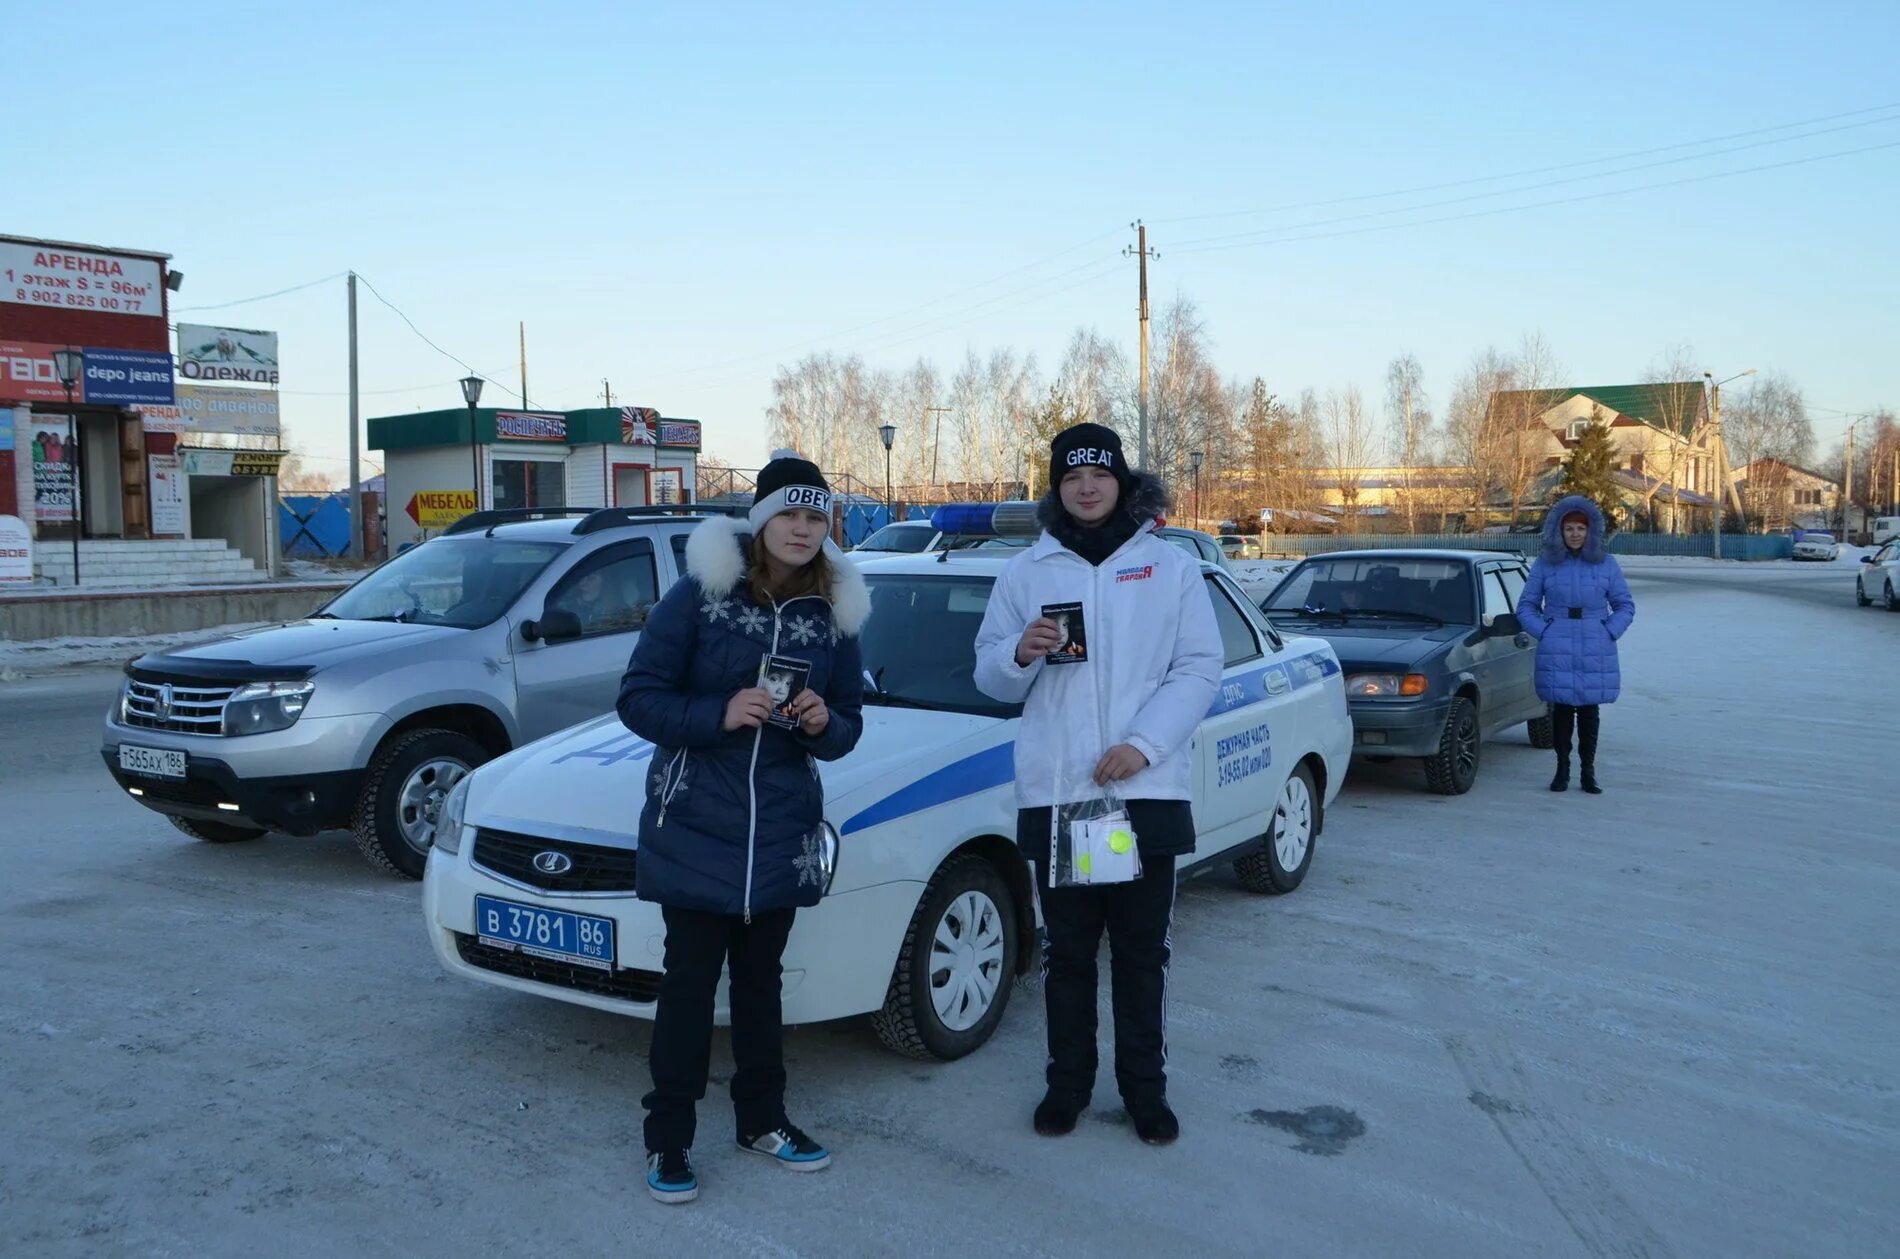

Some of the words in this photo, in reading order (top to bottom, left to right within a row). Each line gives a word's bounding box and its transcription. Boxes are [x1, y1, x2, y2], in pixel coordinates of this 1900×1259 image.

[33, 252, 124, 277] АРЕНДА
[5, 269, 14, 283] 1
[23, 274, 71, 288] этаж
[77, 277, 88, 290] S
[16, 288, 26, 300] 8
[32, 290, 61, 304] 902
[67, 293, 95, 307] 825
[101, 297, 119, 310] 00
[124, 300, 142, 312] 77
[87, 366, 126, 382] depo
[129, 368, 170, 383] jeans
[182, 360, 279, 384] Одежда
[208, 399, 277, 415] ДИВАНОВ
[499, 416, 564, 436] РОСПЕЧАТЬ
[1066, 448, 1113, 467] GREAT
[40, 492, 72, 505] 20%
[420, 494, 474, 510] МЕБЕЛЬ
[788, 488, 830, 509] OBEY
[1222, 683, 1245, 707] ДПС
[1216, 730, 1250, 763] ДЕЖУРНАЯ
[1250, 723, 1270, 745] ЧАСТЬ
[487, 909, 500, 933] В
[508, 907, 565, 947] 3781
[580, 919, 604, 945] 86
[583, 943, 602, 955] RUS
